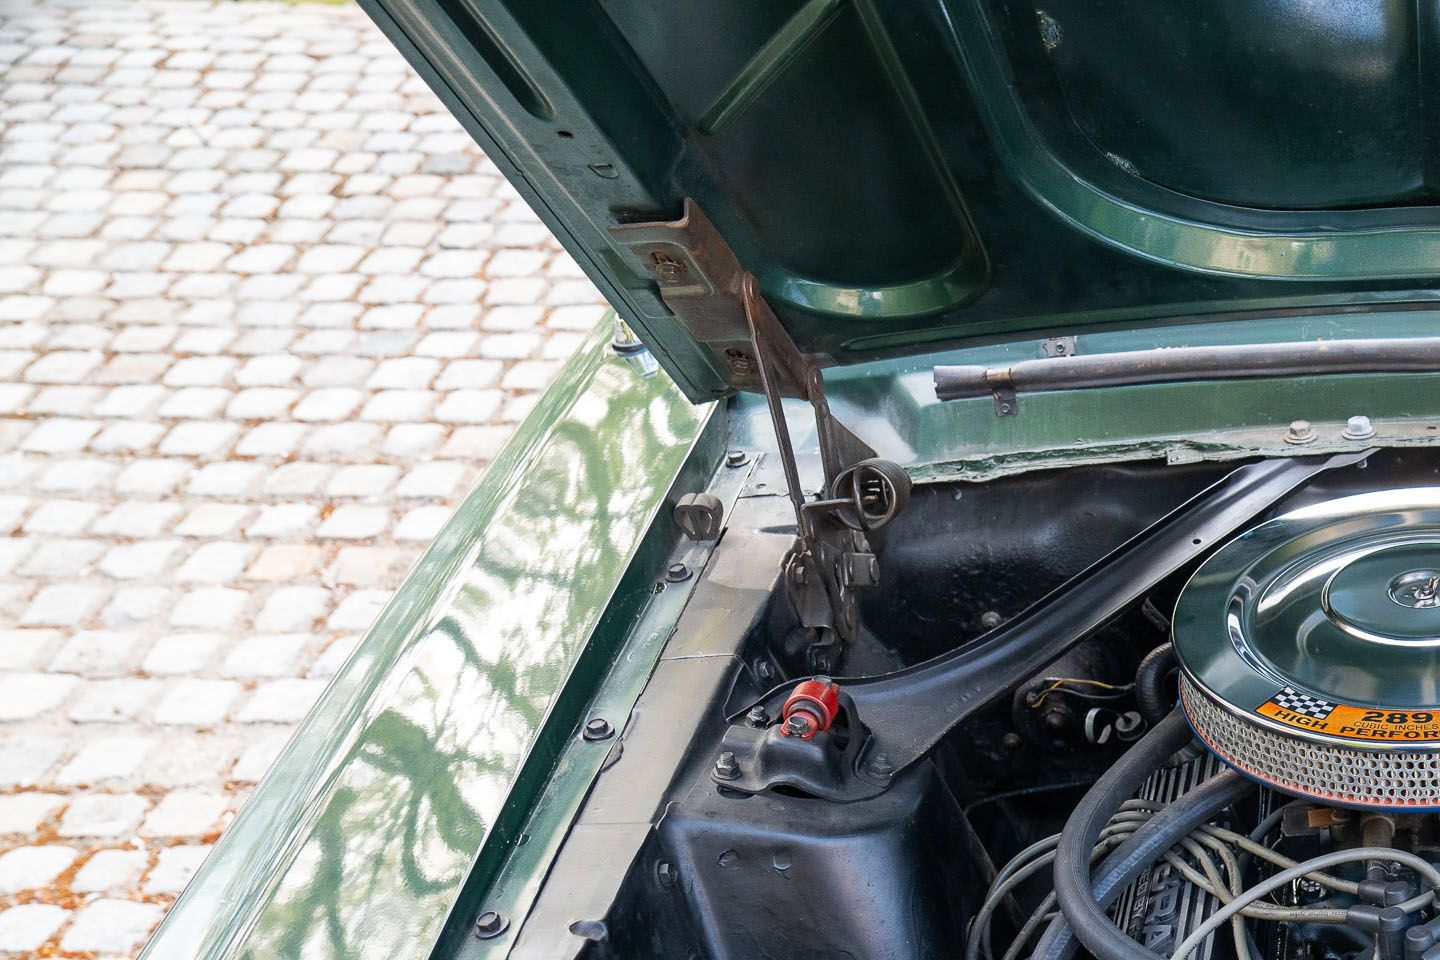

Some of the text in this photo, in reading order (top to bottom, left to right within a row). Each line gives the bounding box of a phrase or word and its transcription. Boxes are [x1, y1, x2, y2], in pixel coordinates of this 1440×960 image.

[1274, 710, 1329, 730] HIGH
[1361, 710, 1434, 725] 289
[1353, 721, 1439, 732] CUBIC INCHES
